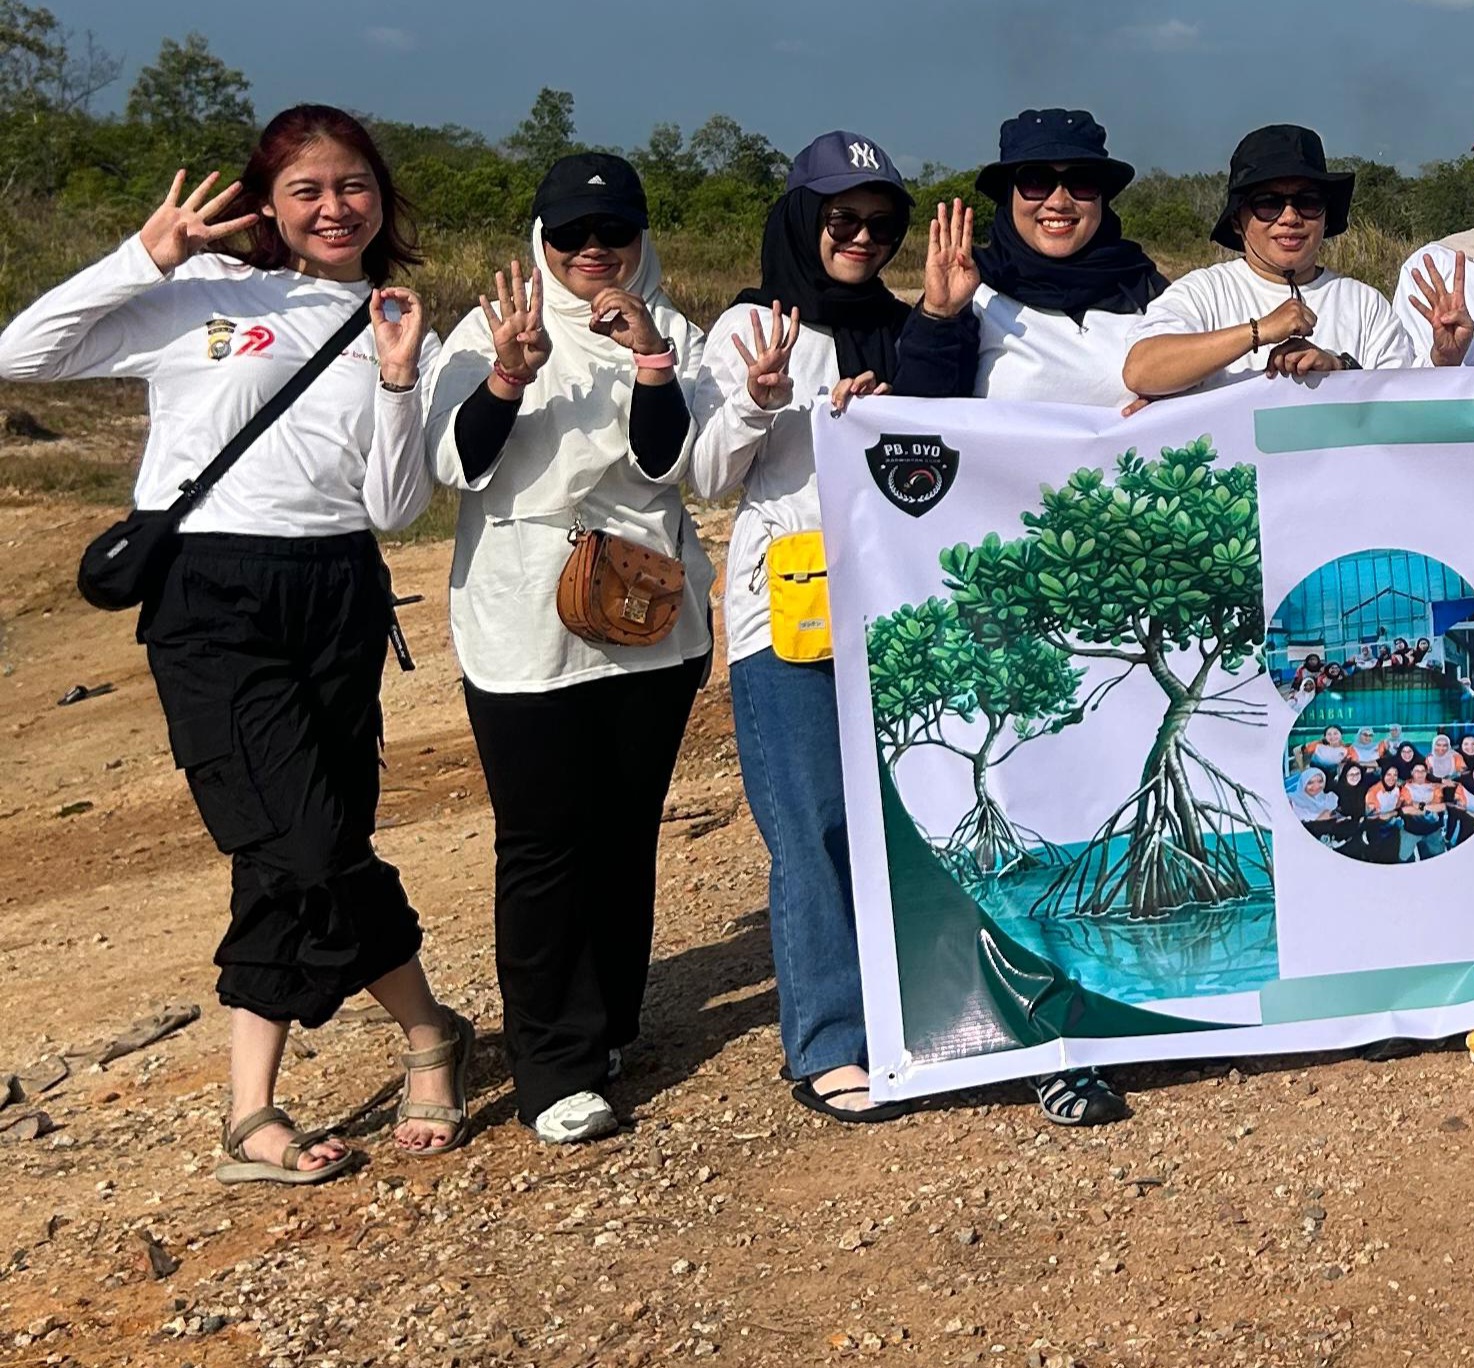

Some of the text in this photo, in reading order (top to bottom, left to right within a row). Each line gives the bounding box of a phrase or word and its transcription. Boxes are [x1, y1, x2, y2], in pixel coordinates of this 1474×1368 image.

[848, 142, 880, 170] NY
[883, 443, 941, 457] PB. OYO
